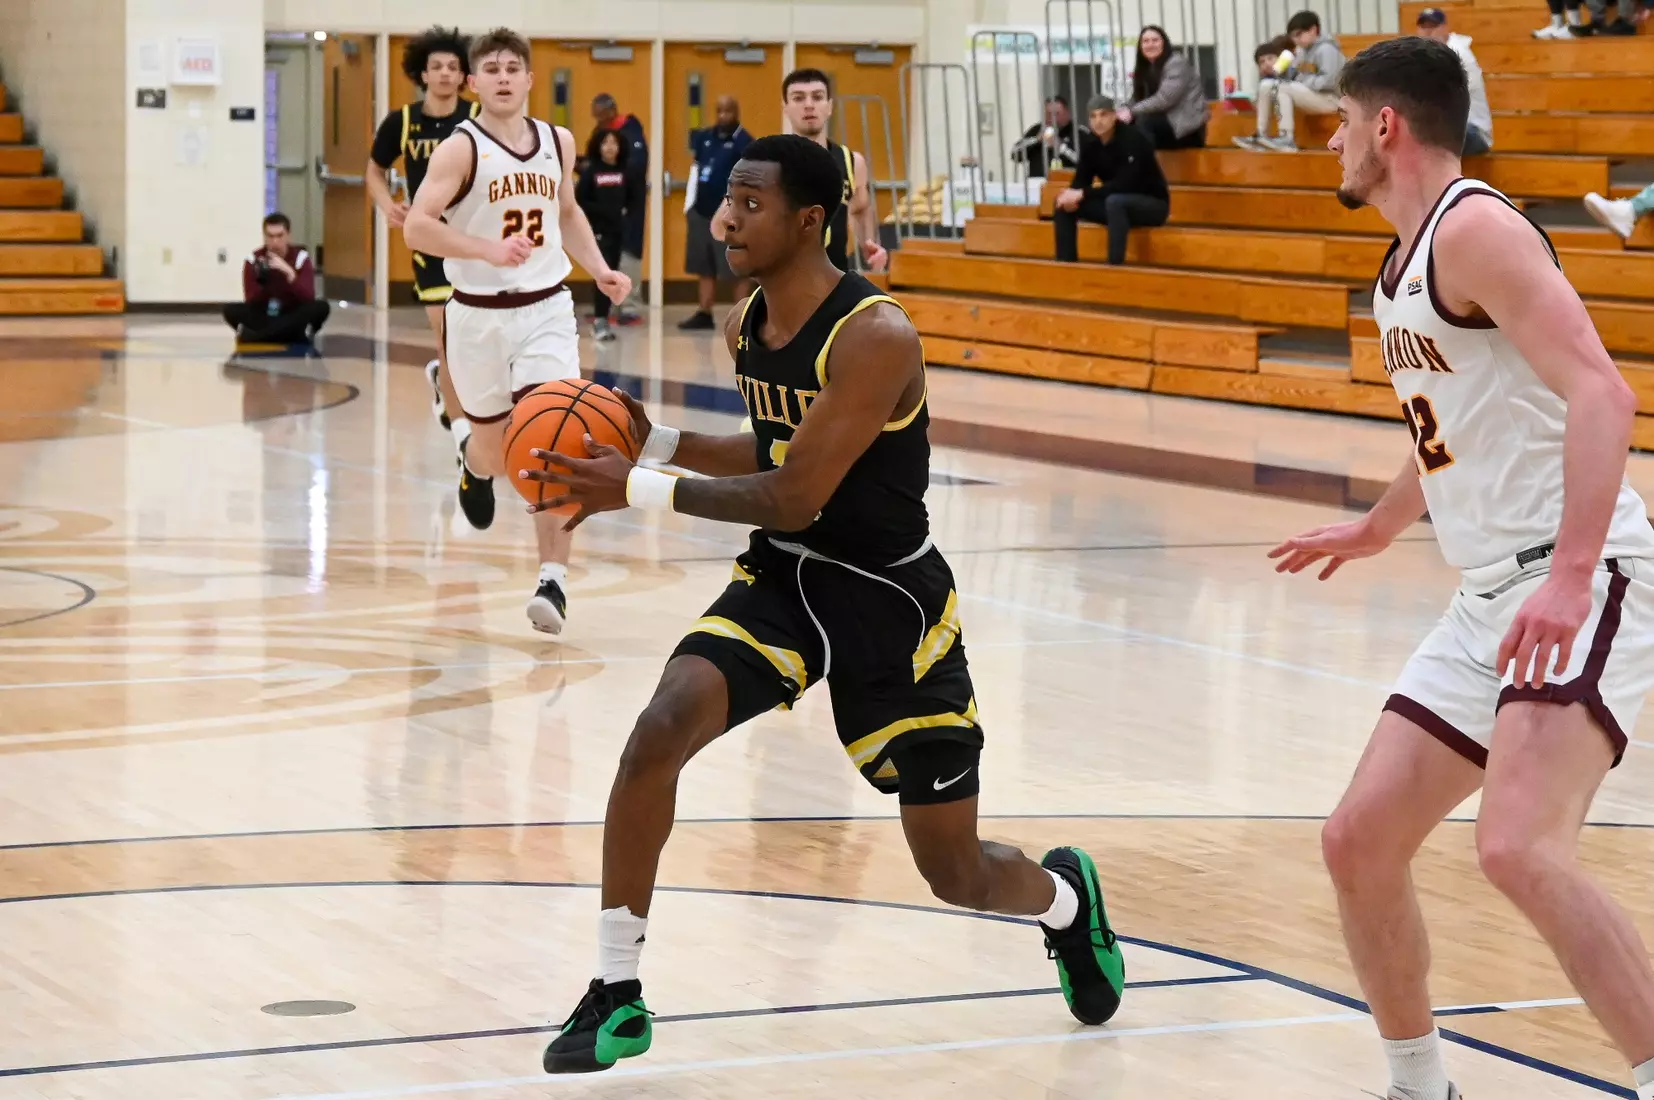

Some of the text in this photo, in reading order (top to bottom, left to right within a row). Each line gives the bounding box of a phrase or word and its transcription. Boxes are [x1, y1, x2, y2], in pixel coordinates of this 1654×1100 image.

[489, 172, 556, 203] GANNON
[502, 208, 544, 247] 22
[1407, 279, 1423, 292] PSAC
